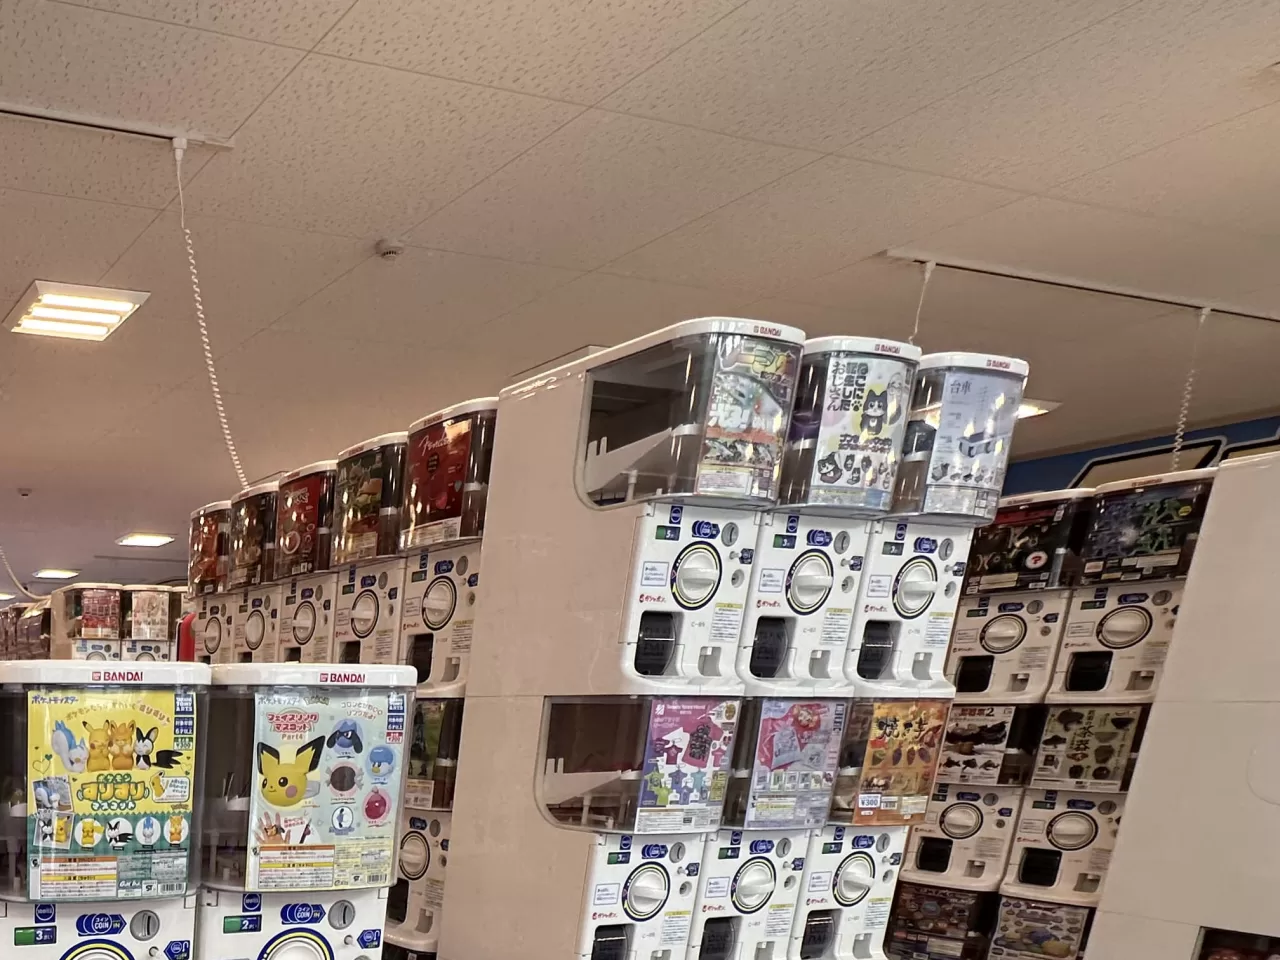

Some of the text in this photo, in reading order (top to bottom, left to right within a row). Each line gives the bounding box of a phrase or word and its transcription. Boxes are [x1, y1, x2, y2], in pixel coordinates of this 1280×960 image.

[760, 327, 781, 336] BANDAI
[881, 345, 901, 354] BANDAI
[991, 360, 1010, 369] BANDAI
[827, 361, 845, 412] おじさん
[103, 672, 143, 681] BANDAI
[330, 674, 365, 682] BANDAI
[95, 921, 109, 929] COIN
